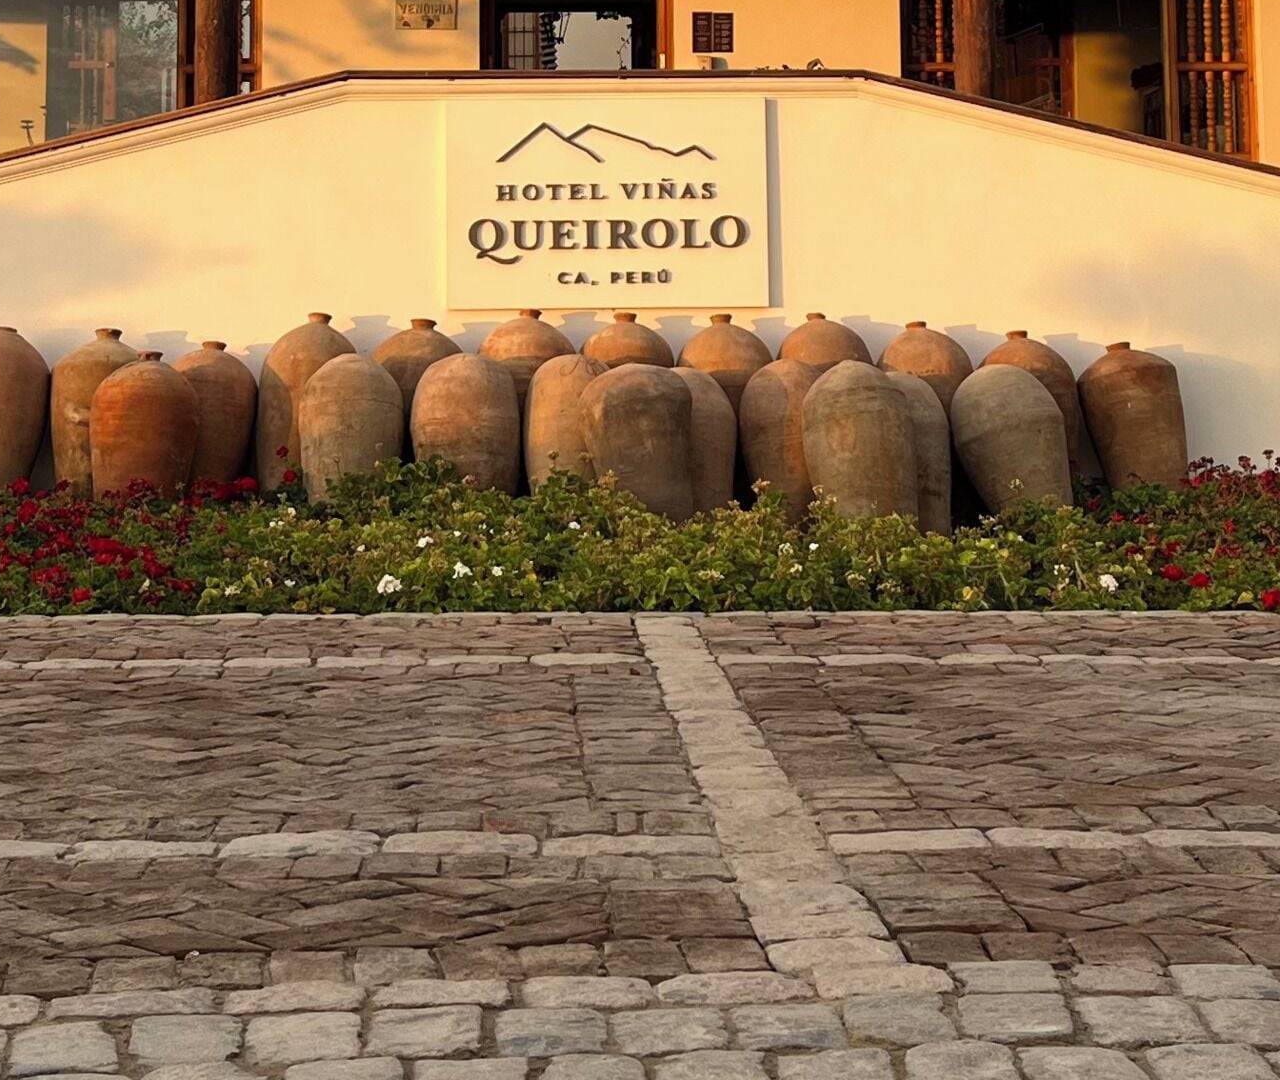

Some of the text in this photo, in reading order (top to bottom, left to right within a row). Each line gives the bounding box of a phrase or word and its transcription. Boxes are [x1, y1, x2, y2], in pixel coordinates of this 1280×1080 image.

[496, 178, 717, 201] HOTEL VIÑAS
[468, 215, 750, 265] QUEIROLO
[610, 268, 671, 284] PERÚ
